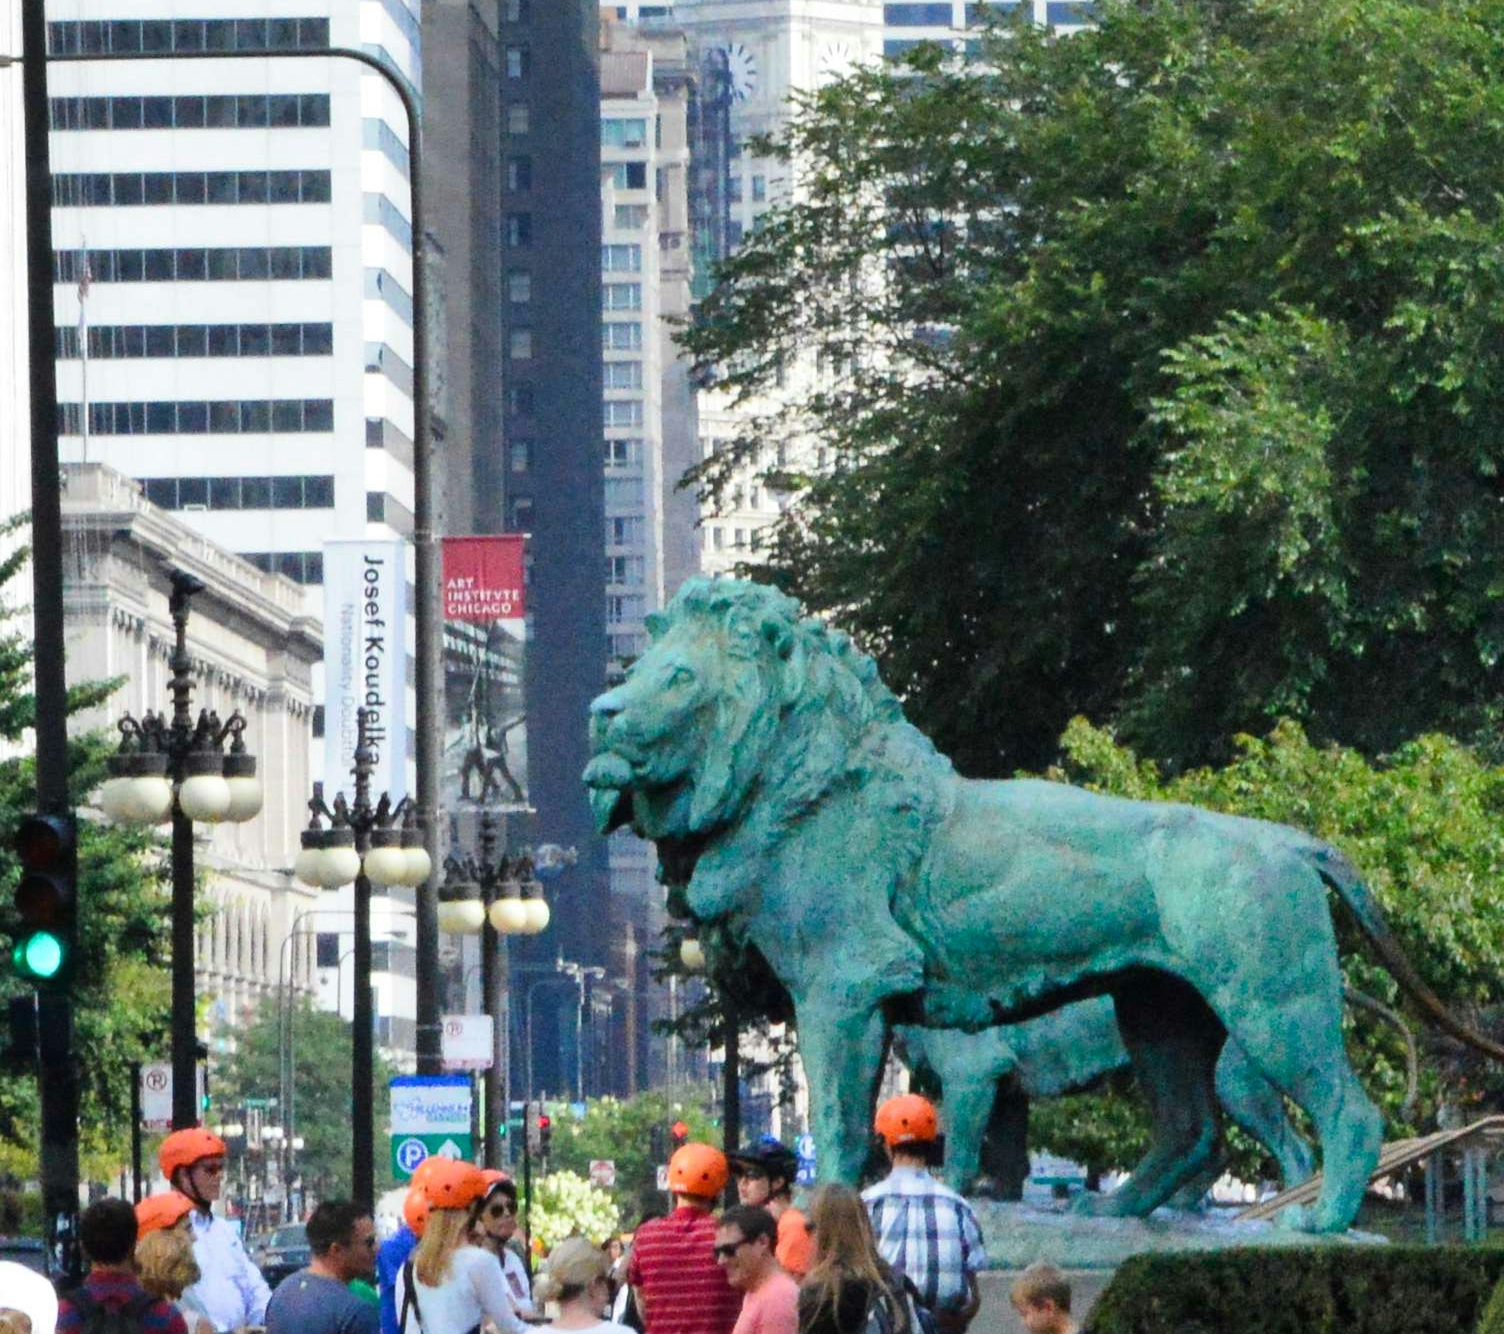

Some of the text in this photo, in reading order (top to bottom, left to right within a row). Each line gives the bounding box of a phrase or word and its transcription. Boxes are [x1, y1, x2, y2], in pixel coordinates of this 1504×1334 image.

[447, 576, 475, 589] ART
[363, 554, 384, 628] Josef
[447, 602, 512, 615] CHICAGO
